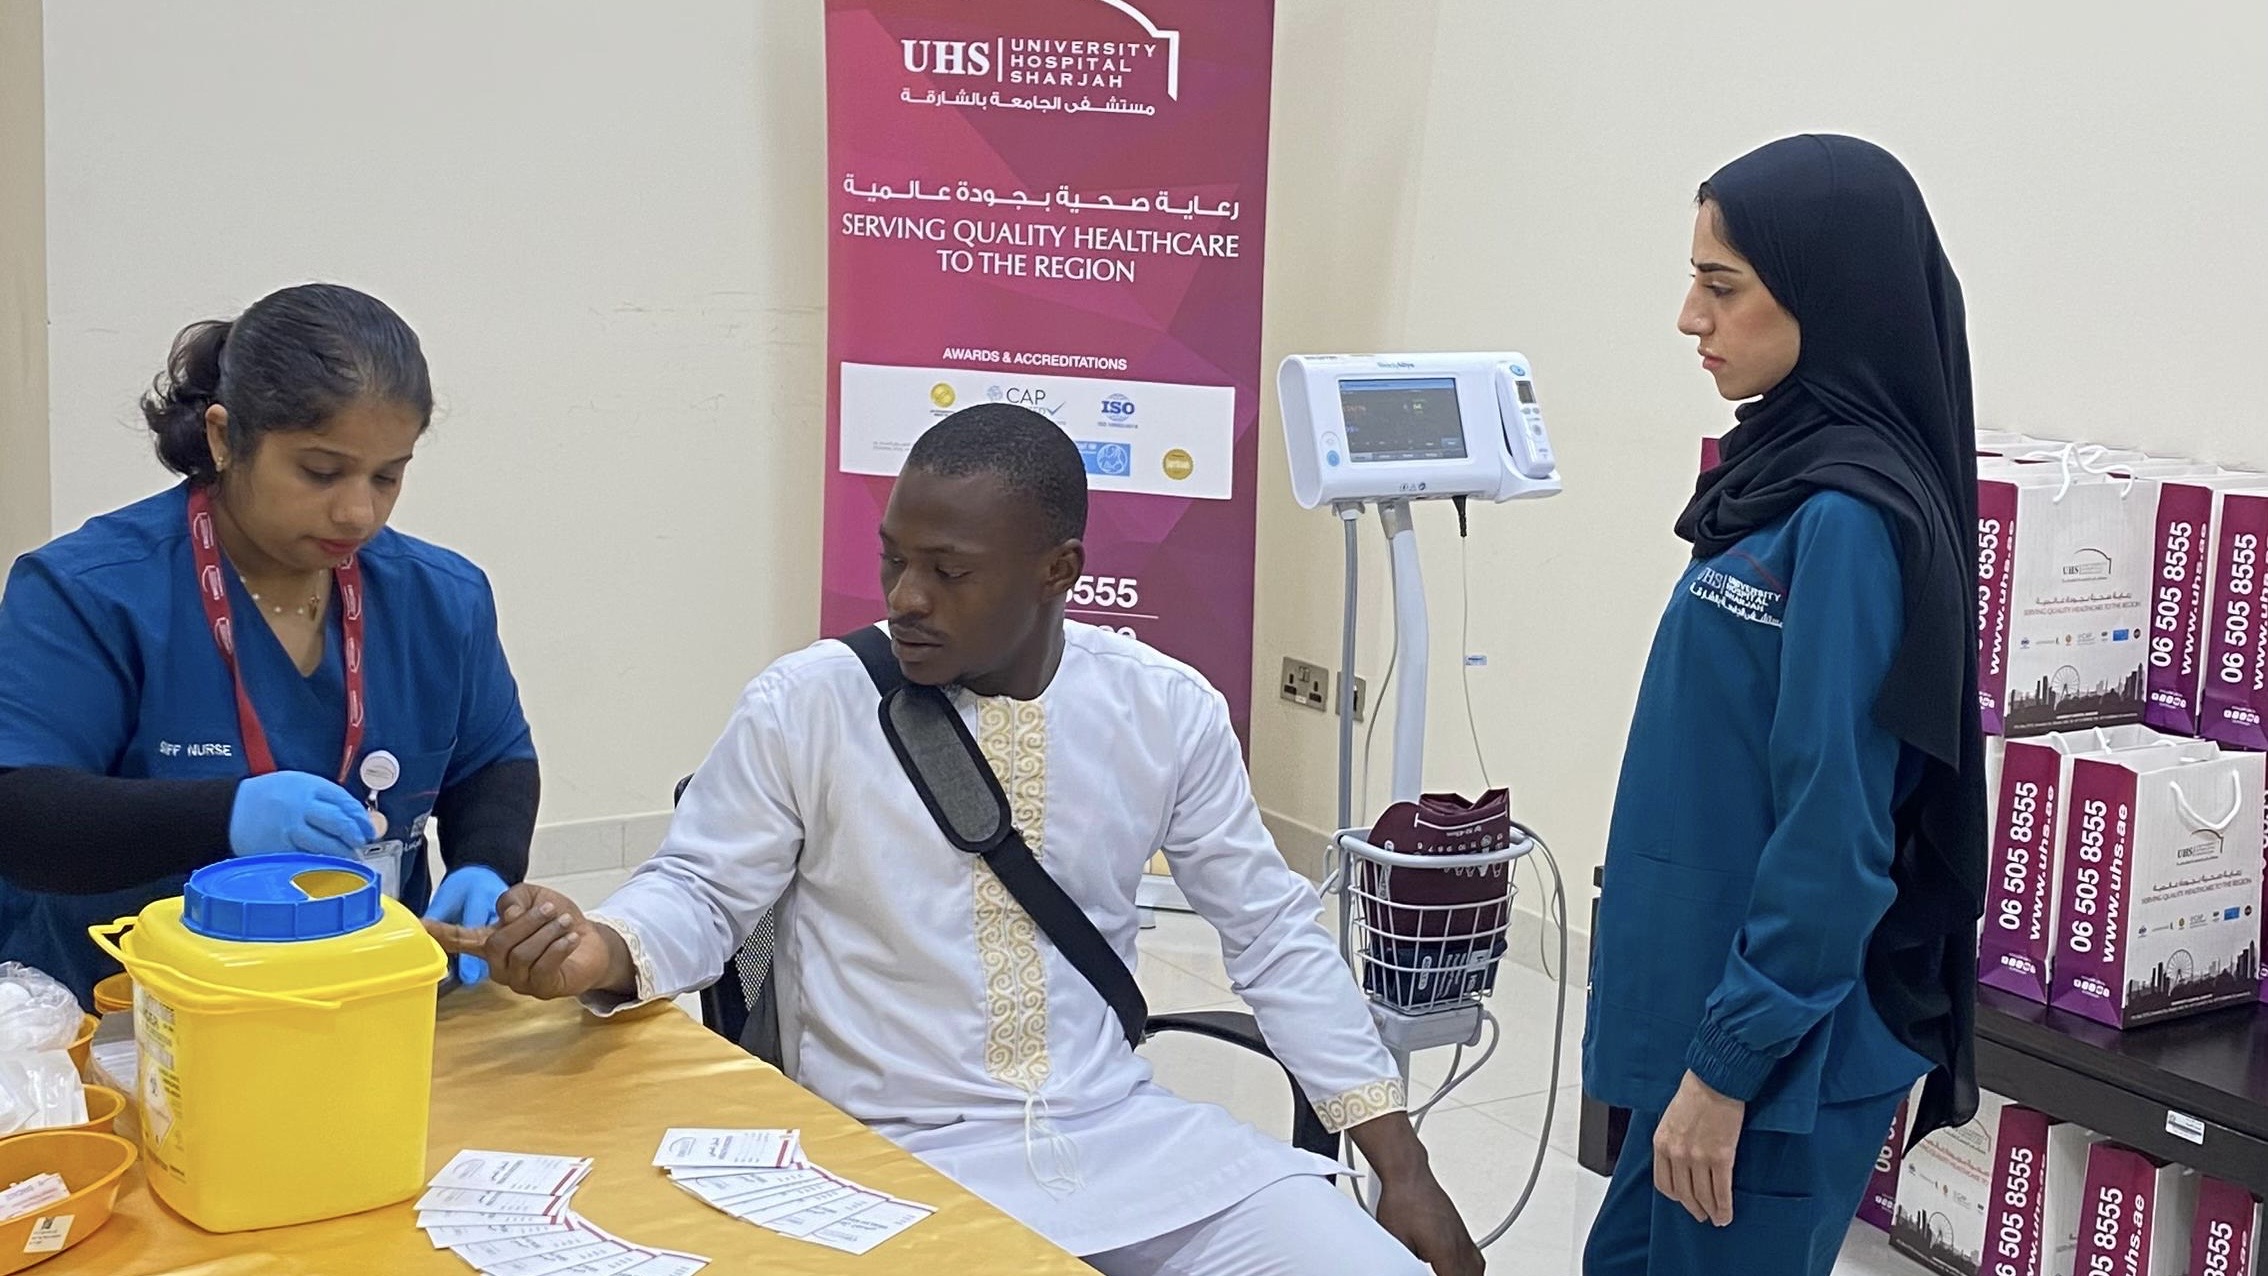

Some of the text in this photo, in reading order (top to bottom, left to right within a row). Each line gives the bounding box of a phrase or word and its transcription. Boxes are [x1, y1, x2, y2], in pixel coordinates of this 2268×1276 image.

[901, 39, 991, 76] UHS
[1010, 39, 1157, 58] UNIVERSITY
[1010, 55, 1132, 73] HOSPITAL
[900, 88, 987, 109] بالشارقة
[1010, 71, 1123, 88] SHARJAH
[989, 91, 1061, 112] الجامعة
[842, 213, 1240, 258] SERVING QUALITY HEALTHCARE
[936, 249, 1136, 282] TO THE REGION
[942, 347, 1128, 371] AWARDS & ACCREDITATIONS
[1006, 387, 1046, 405] CAP
[1101, 400, 1136, 416] ISO
[2163, 521, 2193, 582] 8555
[2155, 586, 2183, 632] 505
[2181, 523, 2208, 676] www.uhs.ae
[2221, 533, 2258, 684] 06 505 8555
[2150, 635, 2175, 667] 06
[187, 743, 232, 757] NURSE
[2079, 799, 2108, 863] 8555
[1998, 781, 2039, 930] 06 505 8555
[2029, 785, 2055, 941] www.uhs.ae
[2075, 867, 2100, 916] 505
[2102, 803, 2128, 964] www.uhs.ae
[2070, 921, 2094, 953] 06
[2005, 1147, 2034, 1208] 8555
[1998, 1211, 2025, 1259] 505
[2093, 1187, 2123, 1251] 8555
